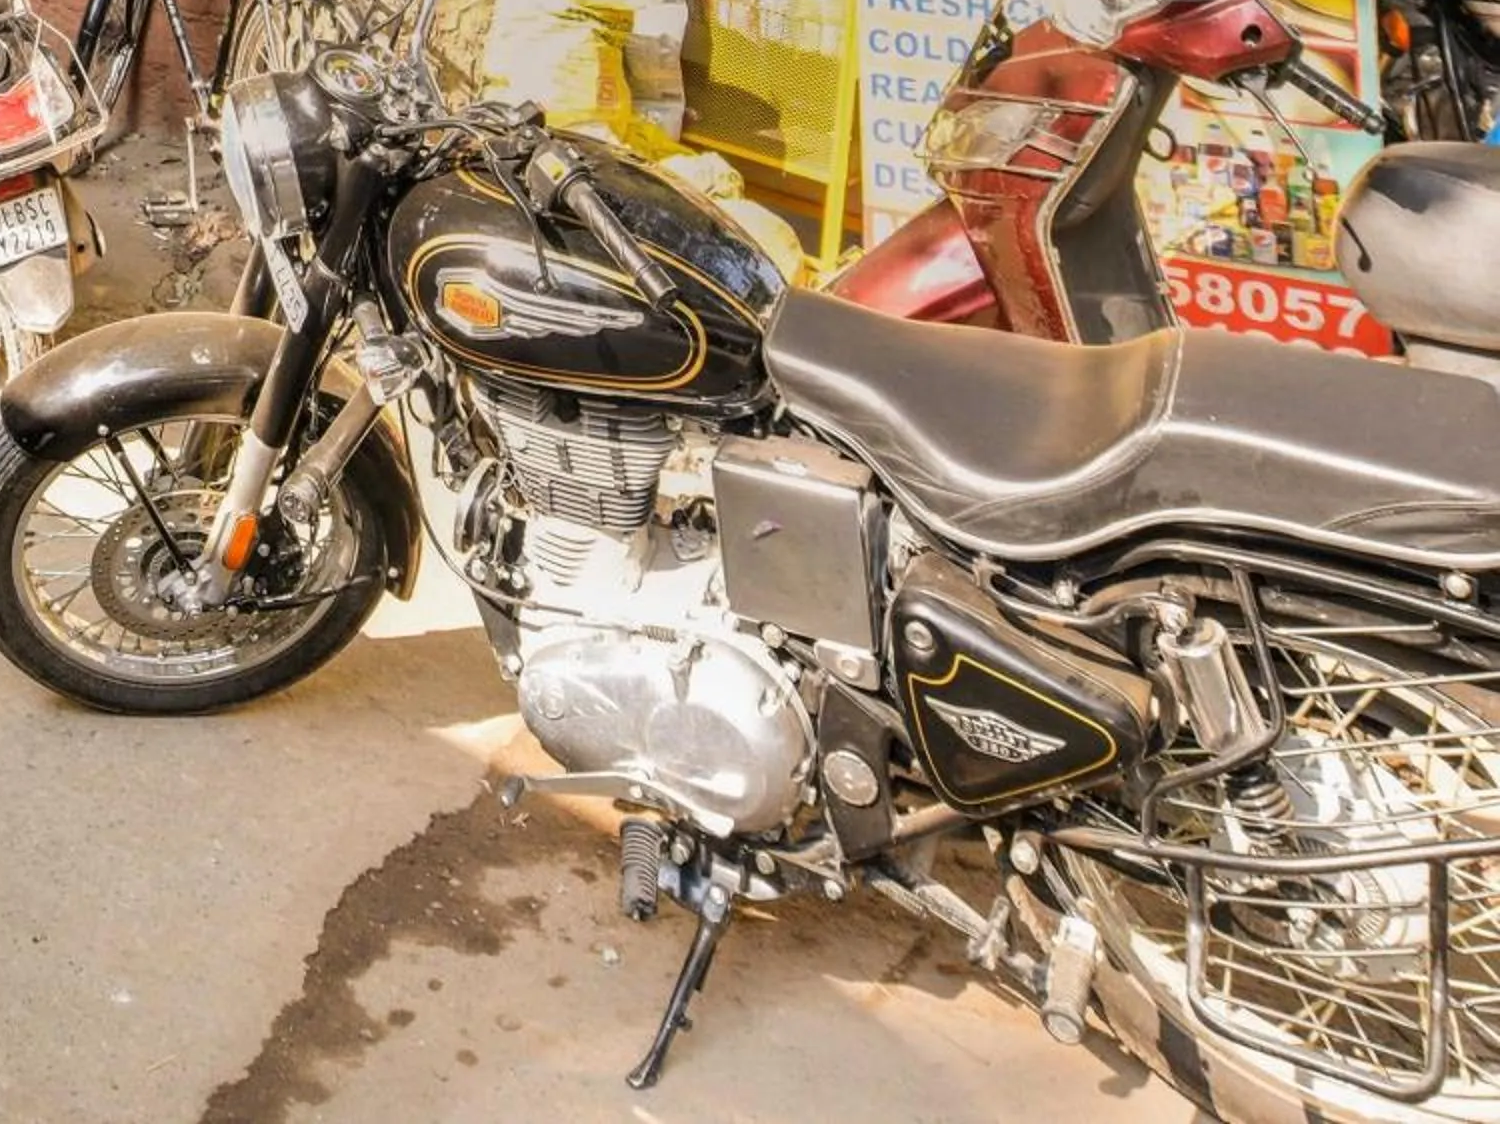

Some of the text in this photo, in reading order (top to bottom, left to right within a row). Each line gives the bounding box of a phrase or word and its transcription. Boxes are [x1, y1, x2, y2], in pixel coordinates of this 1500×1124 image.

[869, 29, 970, 65] COLD
[871, 74, 943, 104] REA
[873, 119, 924, 148] CU
